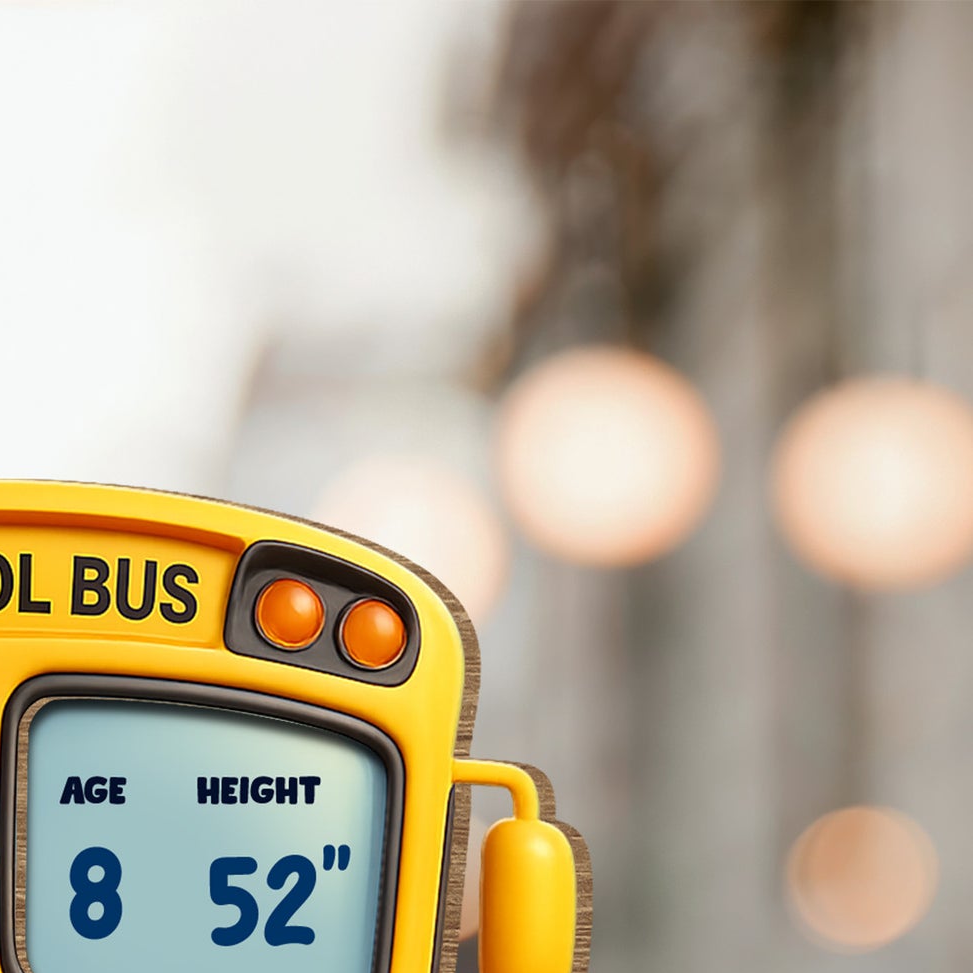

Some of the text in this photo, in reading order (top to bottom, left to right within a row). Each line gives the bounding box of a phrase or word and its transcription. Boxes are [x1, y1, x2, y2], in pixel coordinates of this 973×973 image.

[70, 555, 199, 624] BUS
[59, 775, 127, 805] AGE
[197, 776, 321, 805] HEIGHT
[69, 846, 123, 940] 8
[209, 844, 351, 947] 52"
